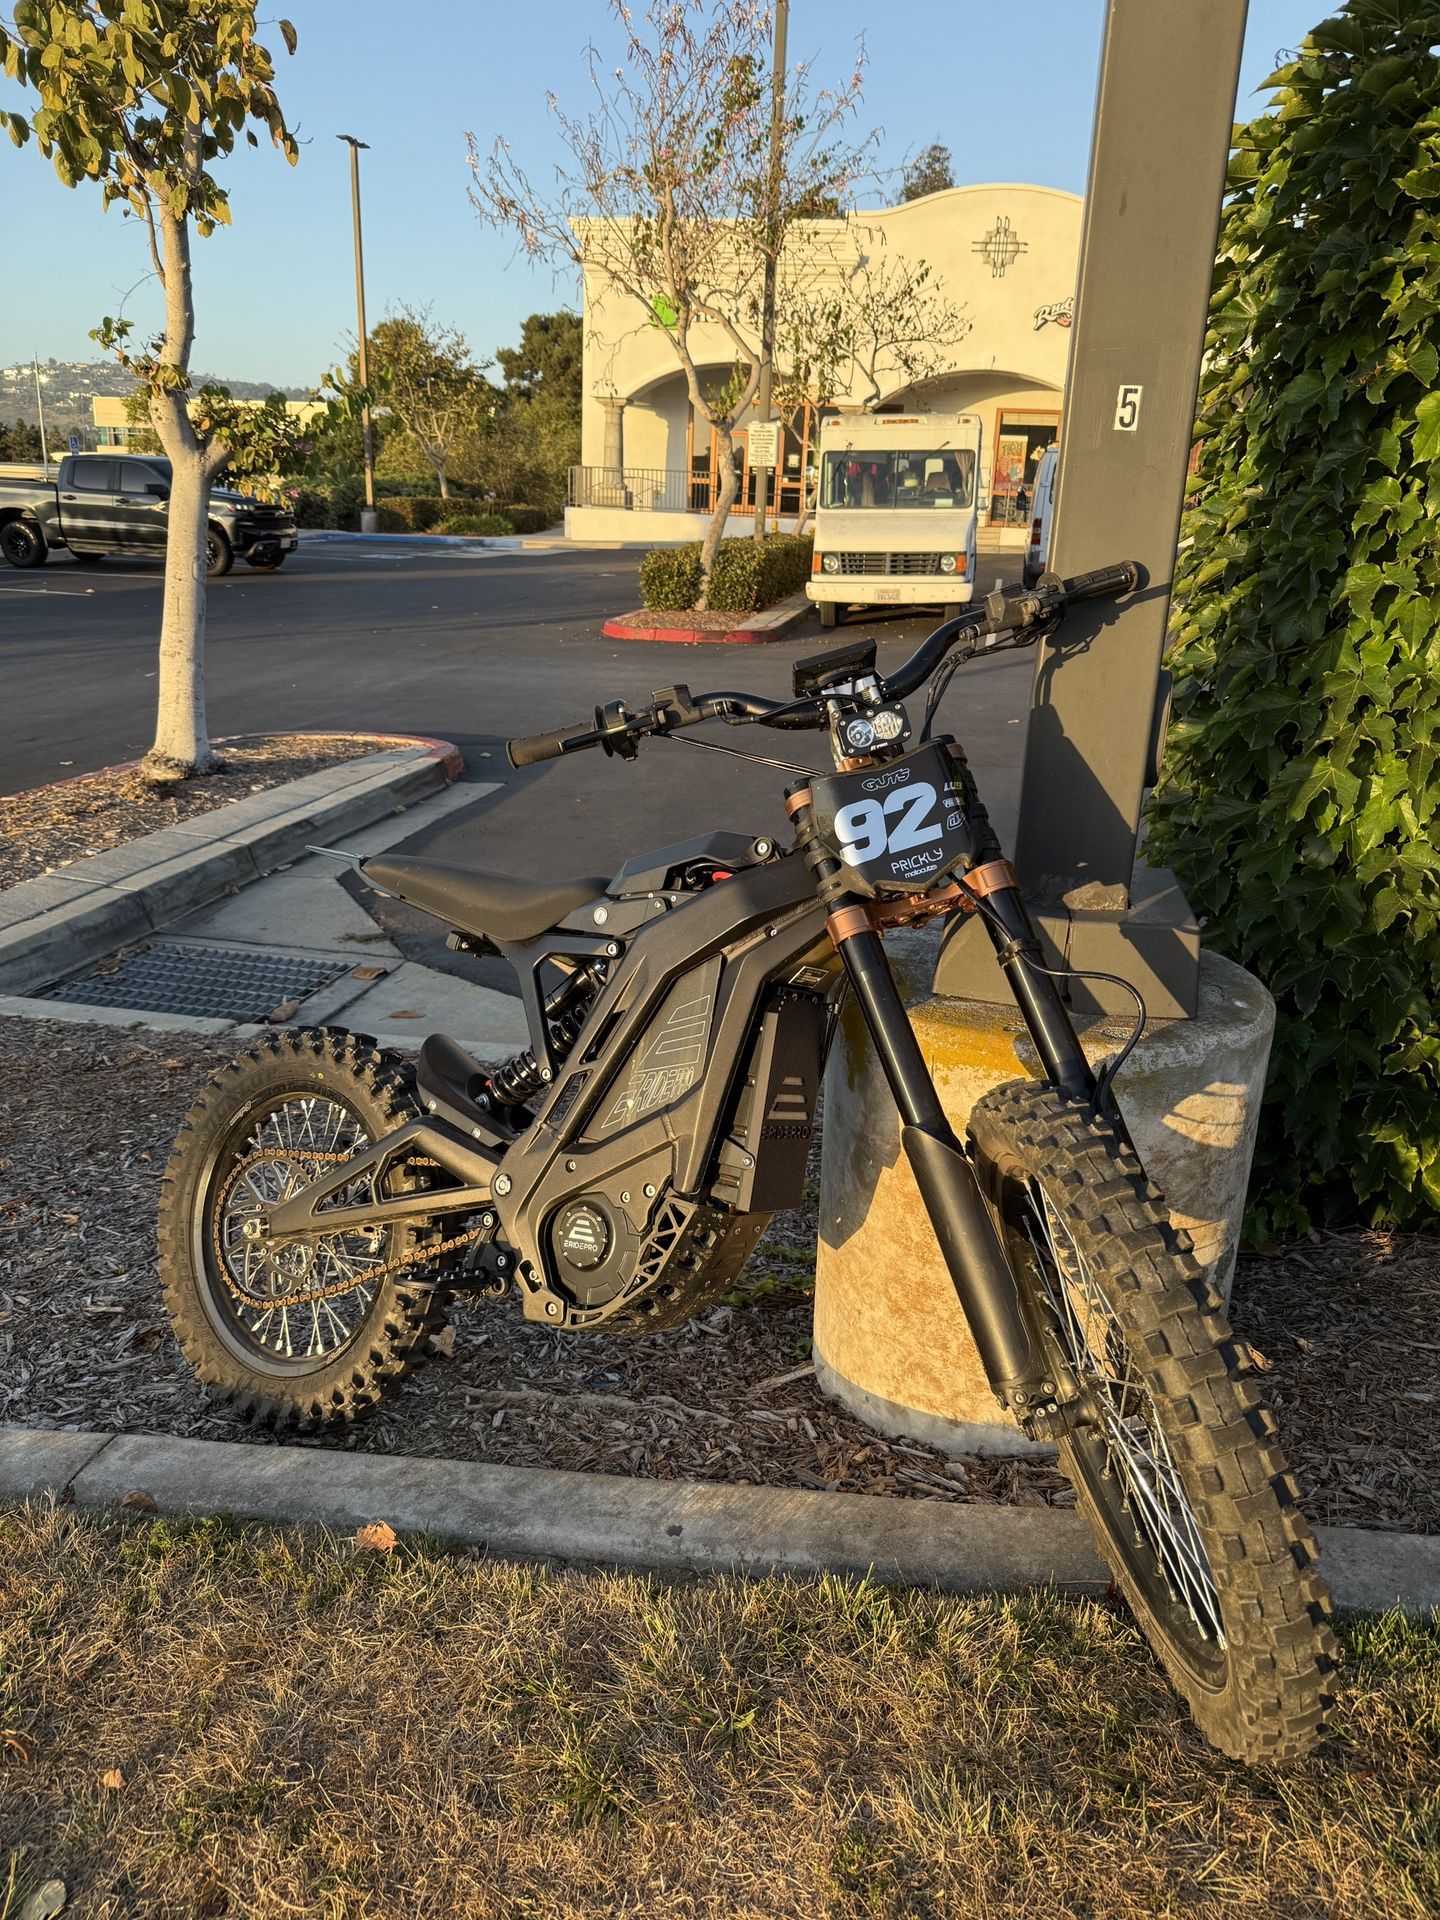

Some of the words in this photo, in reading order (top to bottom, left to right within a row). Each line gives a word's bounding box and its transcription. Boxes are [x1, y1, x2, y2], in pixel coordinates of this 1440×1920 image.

[1119, 388, 1139, 429] 5
[861, 767, 911, 792] GUTS
[834, 781, 943, 867] 92
[890, 847, 944, 875] PRICKLY
[563, 1239, 598, 1252] ERIDEPRO
